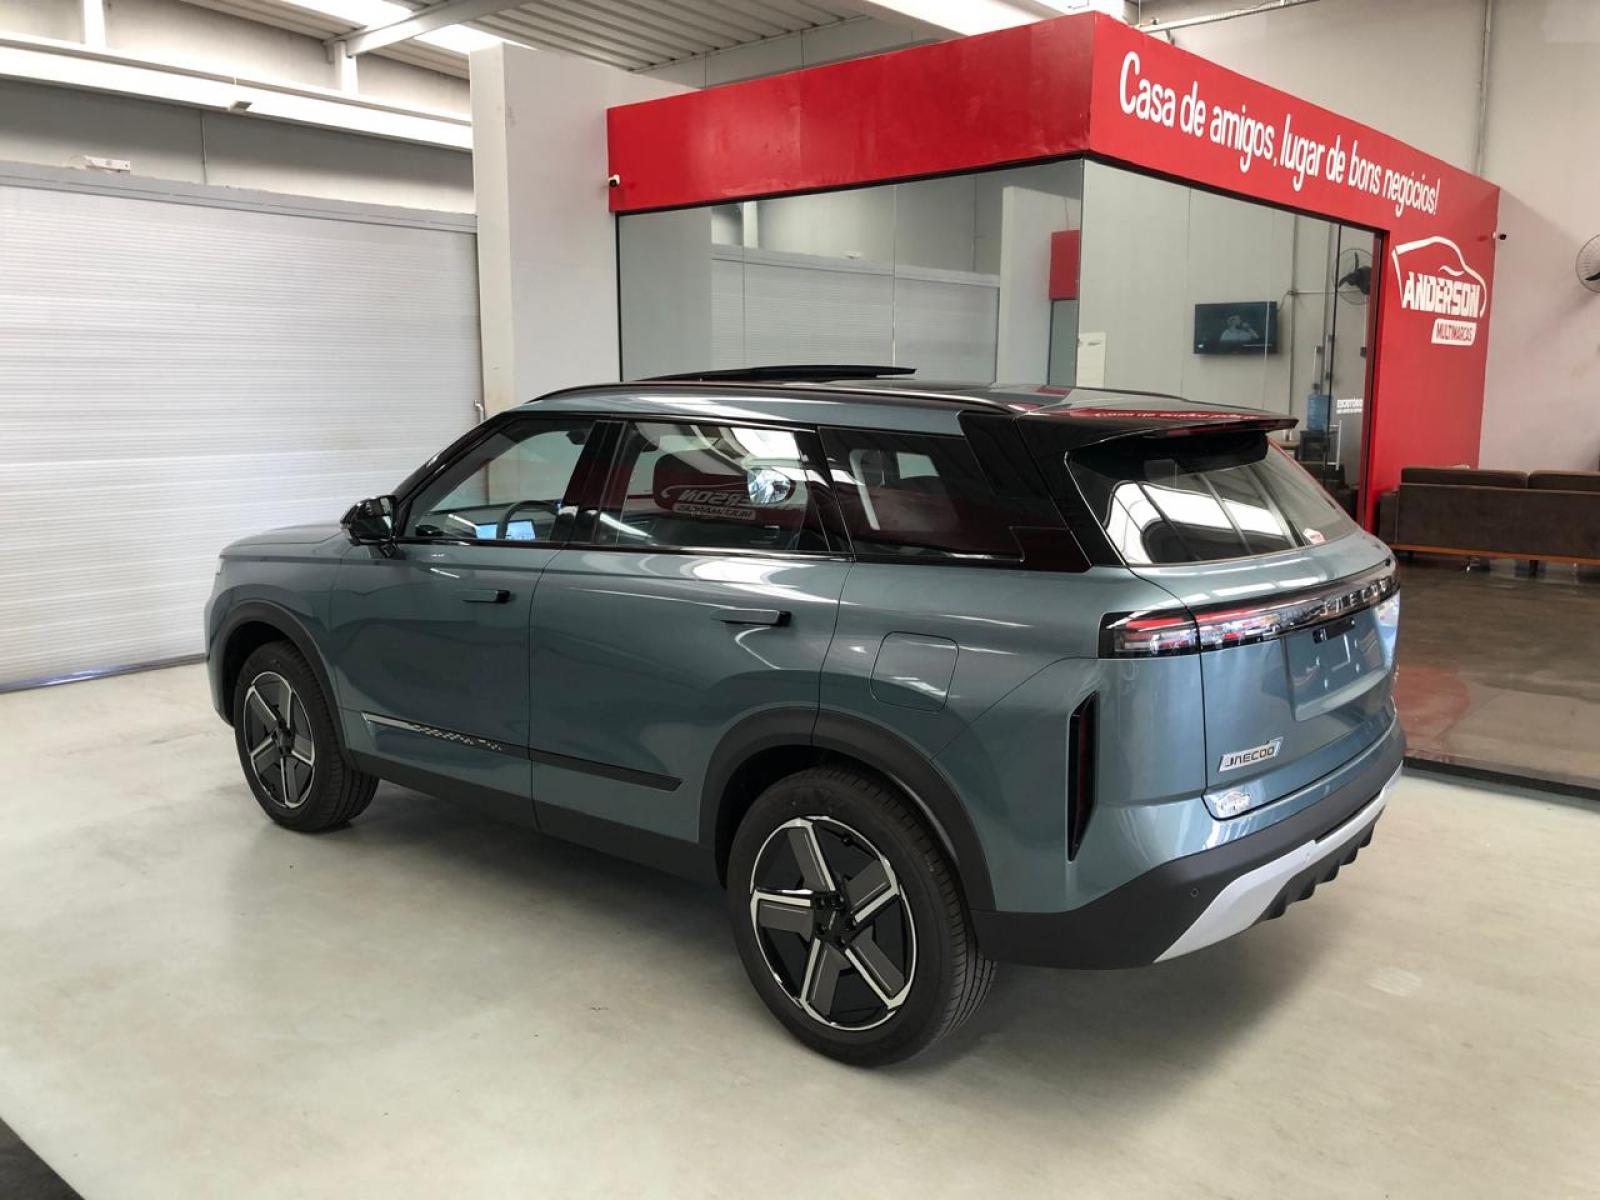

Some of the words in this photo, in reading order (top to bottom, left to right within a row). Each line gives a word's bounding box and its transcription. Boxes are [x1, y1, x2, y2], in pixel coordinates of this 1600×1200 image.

[1119, 51, 1176, 128] Casa
[1180, 80, 1206, 138] de
[1209, 105, 1277, 173] amigos,
[1280, 113, 1325, 192] lugar
[1326, 135, 1346, 184] de
[1348, 140, 1382, 195] bons
[1382, 171, 1440, 218] negócios!
[1402, 271, 1480, 318] ANDERSON
[1224, 746, 1276, 767] JAECOO
